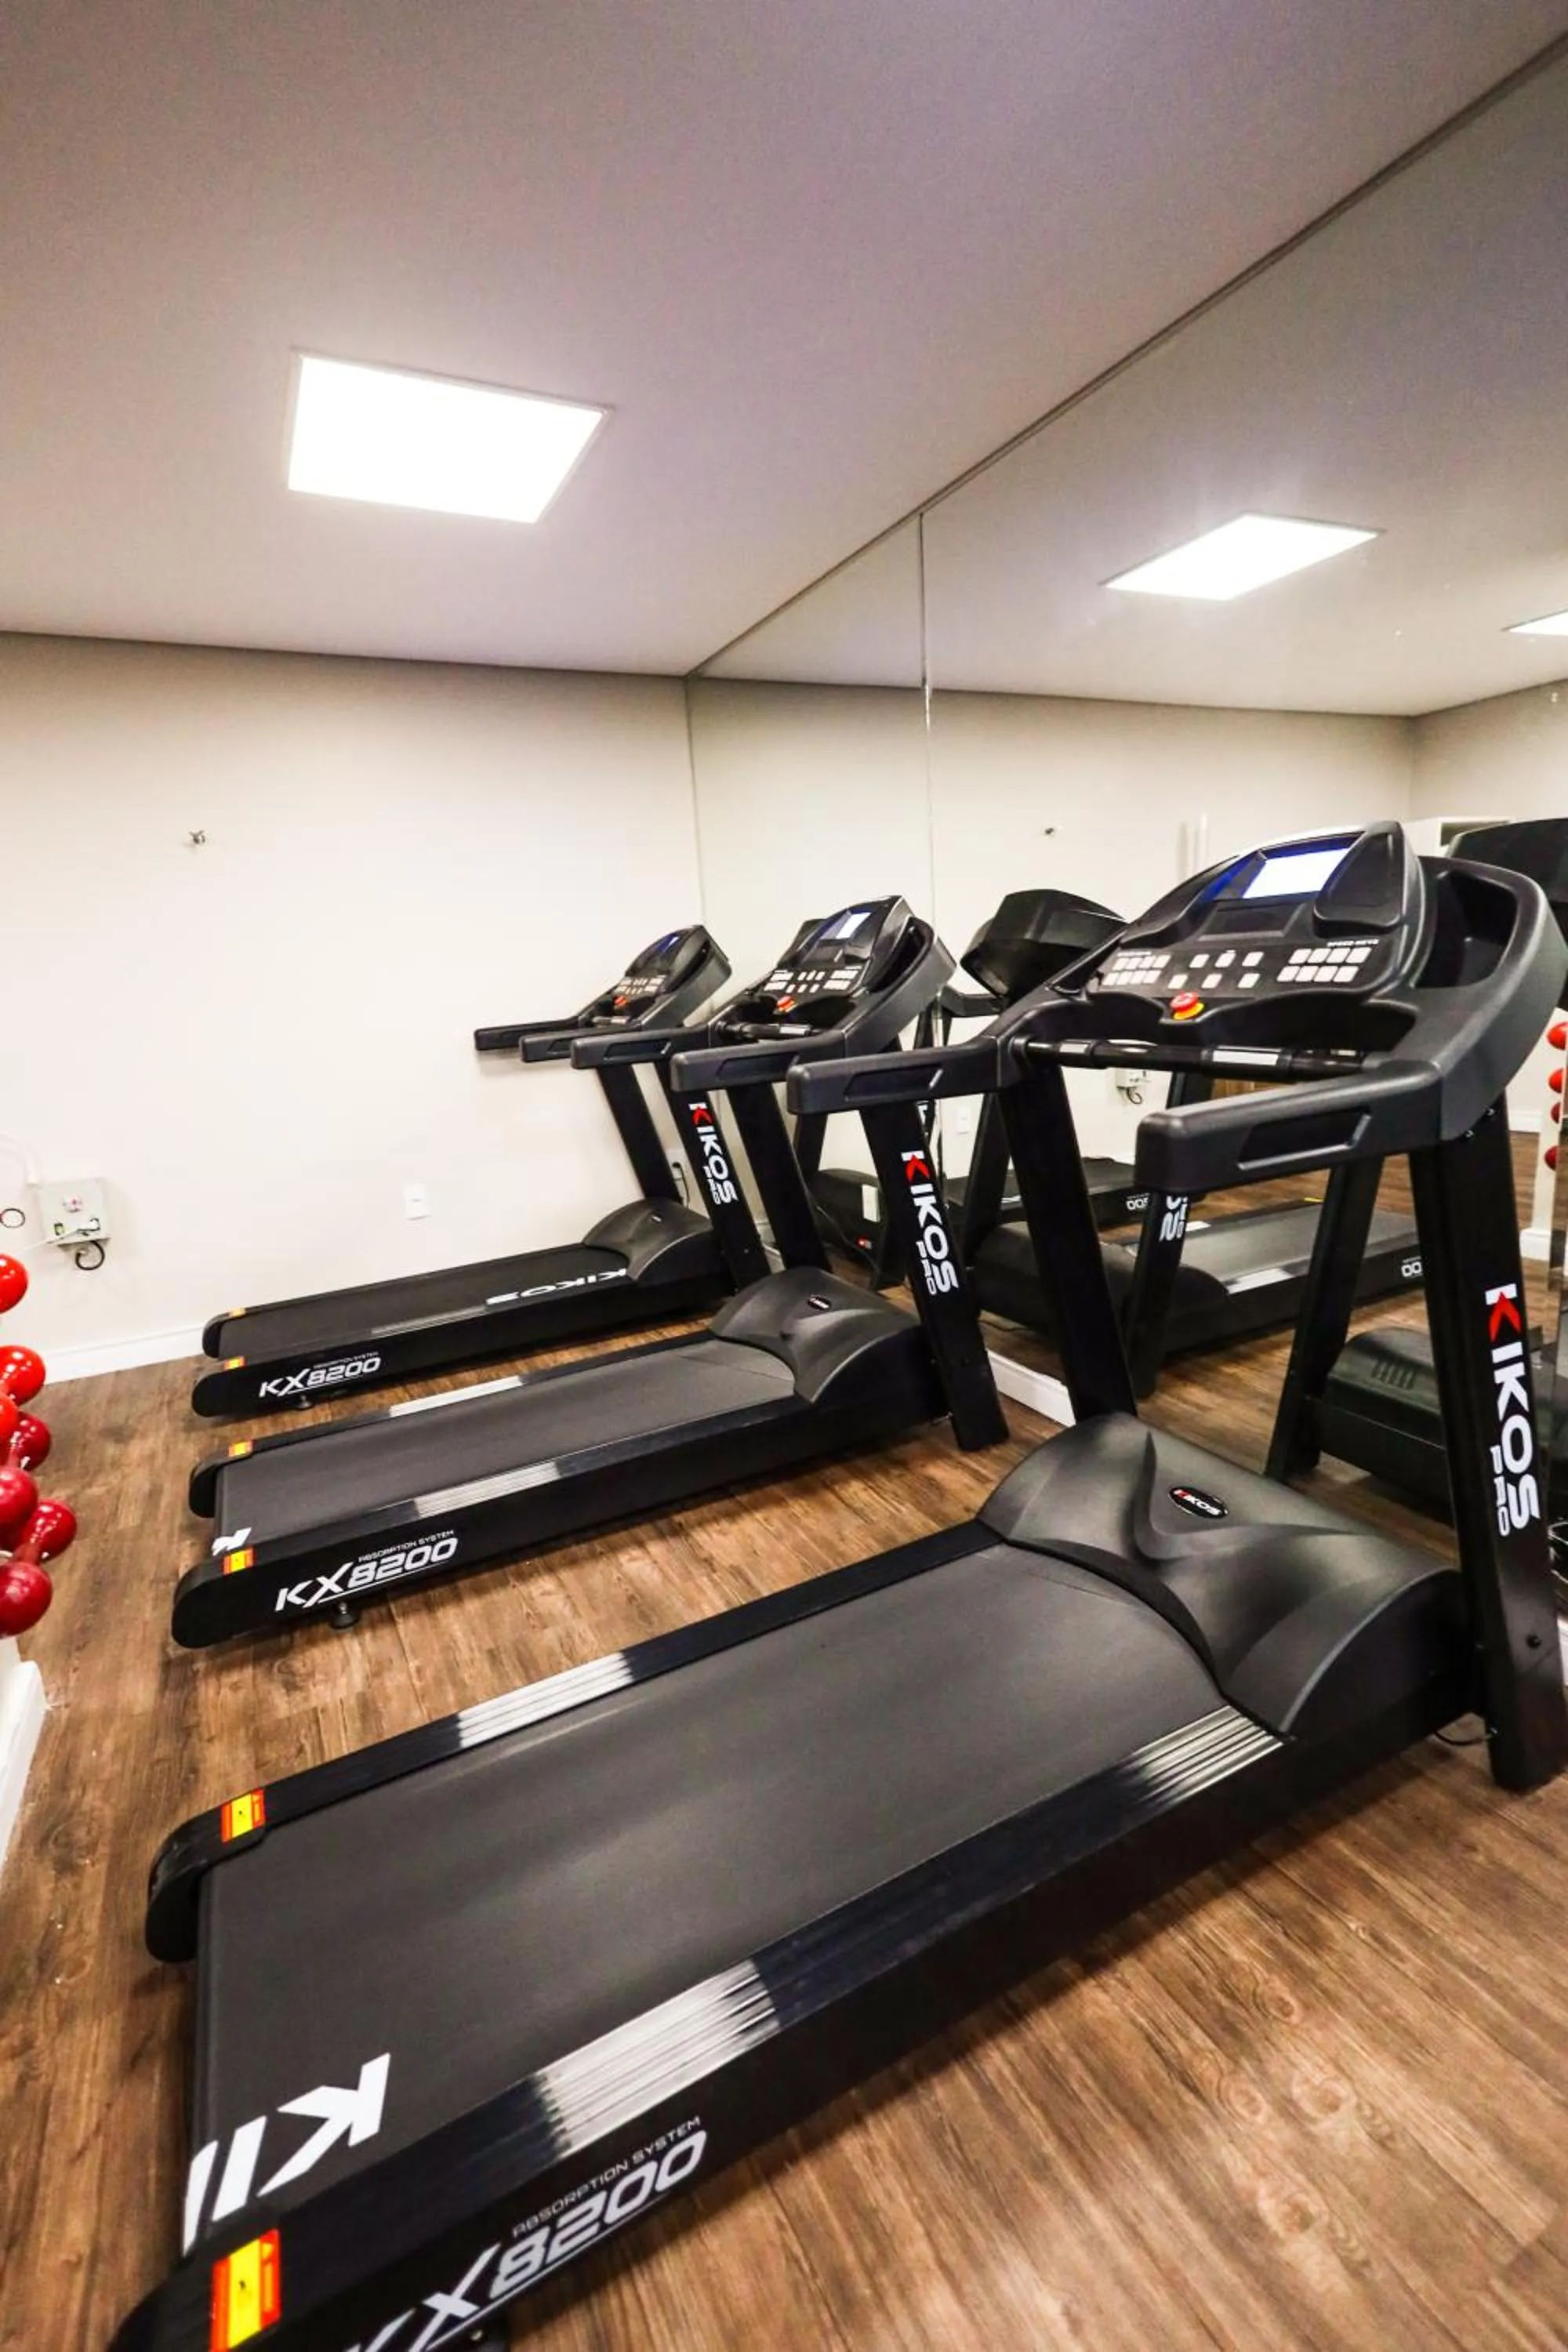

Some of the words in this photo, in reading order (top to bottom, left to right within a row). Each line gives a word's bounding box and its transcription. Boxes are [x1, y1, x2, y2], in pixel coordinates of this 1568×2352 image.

[688, 1102, 739, 1203] KIKOS
[702, 1165, 722, 1205] PRO
[901, 1150, 960, 1294] KIKOS
[915, 1240, 938, 1295] PRO
[259, 1356, 382, 1398] KX8200
[1485, 1283, 1541, 1530] KIKOS
[1173, 1488, 1222, 1515] KIKOS
[1490, 1446, 1511, 1537] PRO
[275, 1537, 459, 1612] KX8200
[417, 1530, 455, 1546] SYSTEM
[512, 2158, 630, 2238] ABSORPTION
[632, 2115, 702, 2165] SYSTEM
